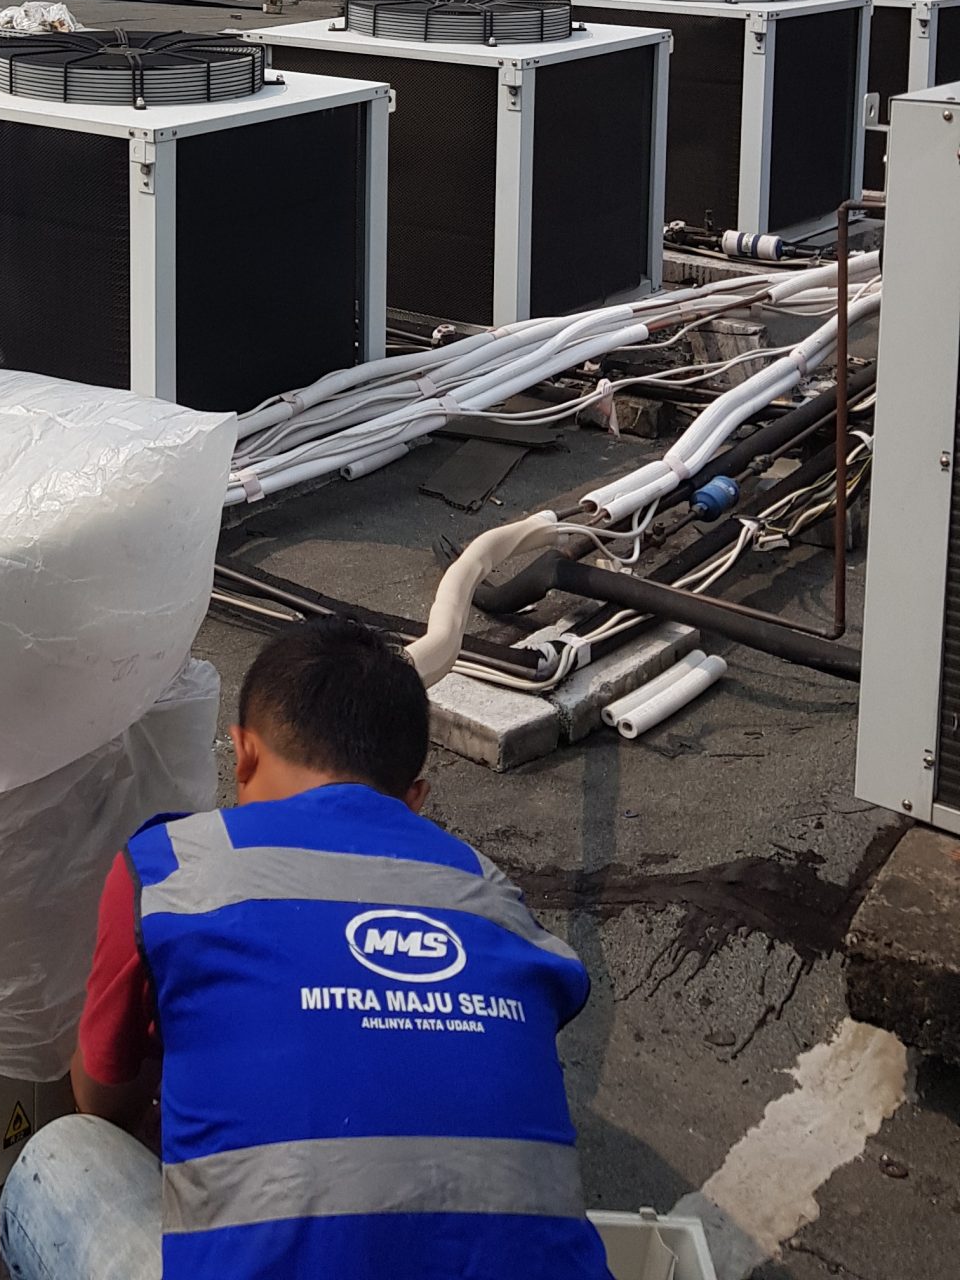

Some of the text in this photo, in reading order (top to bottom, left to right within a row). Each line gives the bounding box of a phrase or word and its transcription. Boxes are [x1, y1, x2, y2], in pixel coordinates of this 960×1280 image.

[364, 928, 448, 958] MMS
[301, 987, 526, 1023] MITRA MAJU SEJATI
[361, 1017, 485, 1033] AHLINYA TATA UDARA
